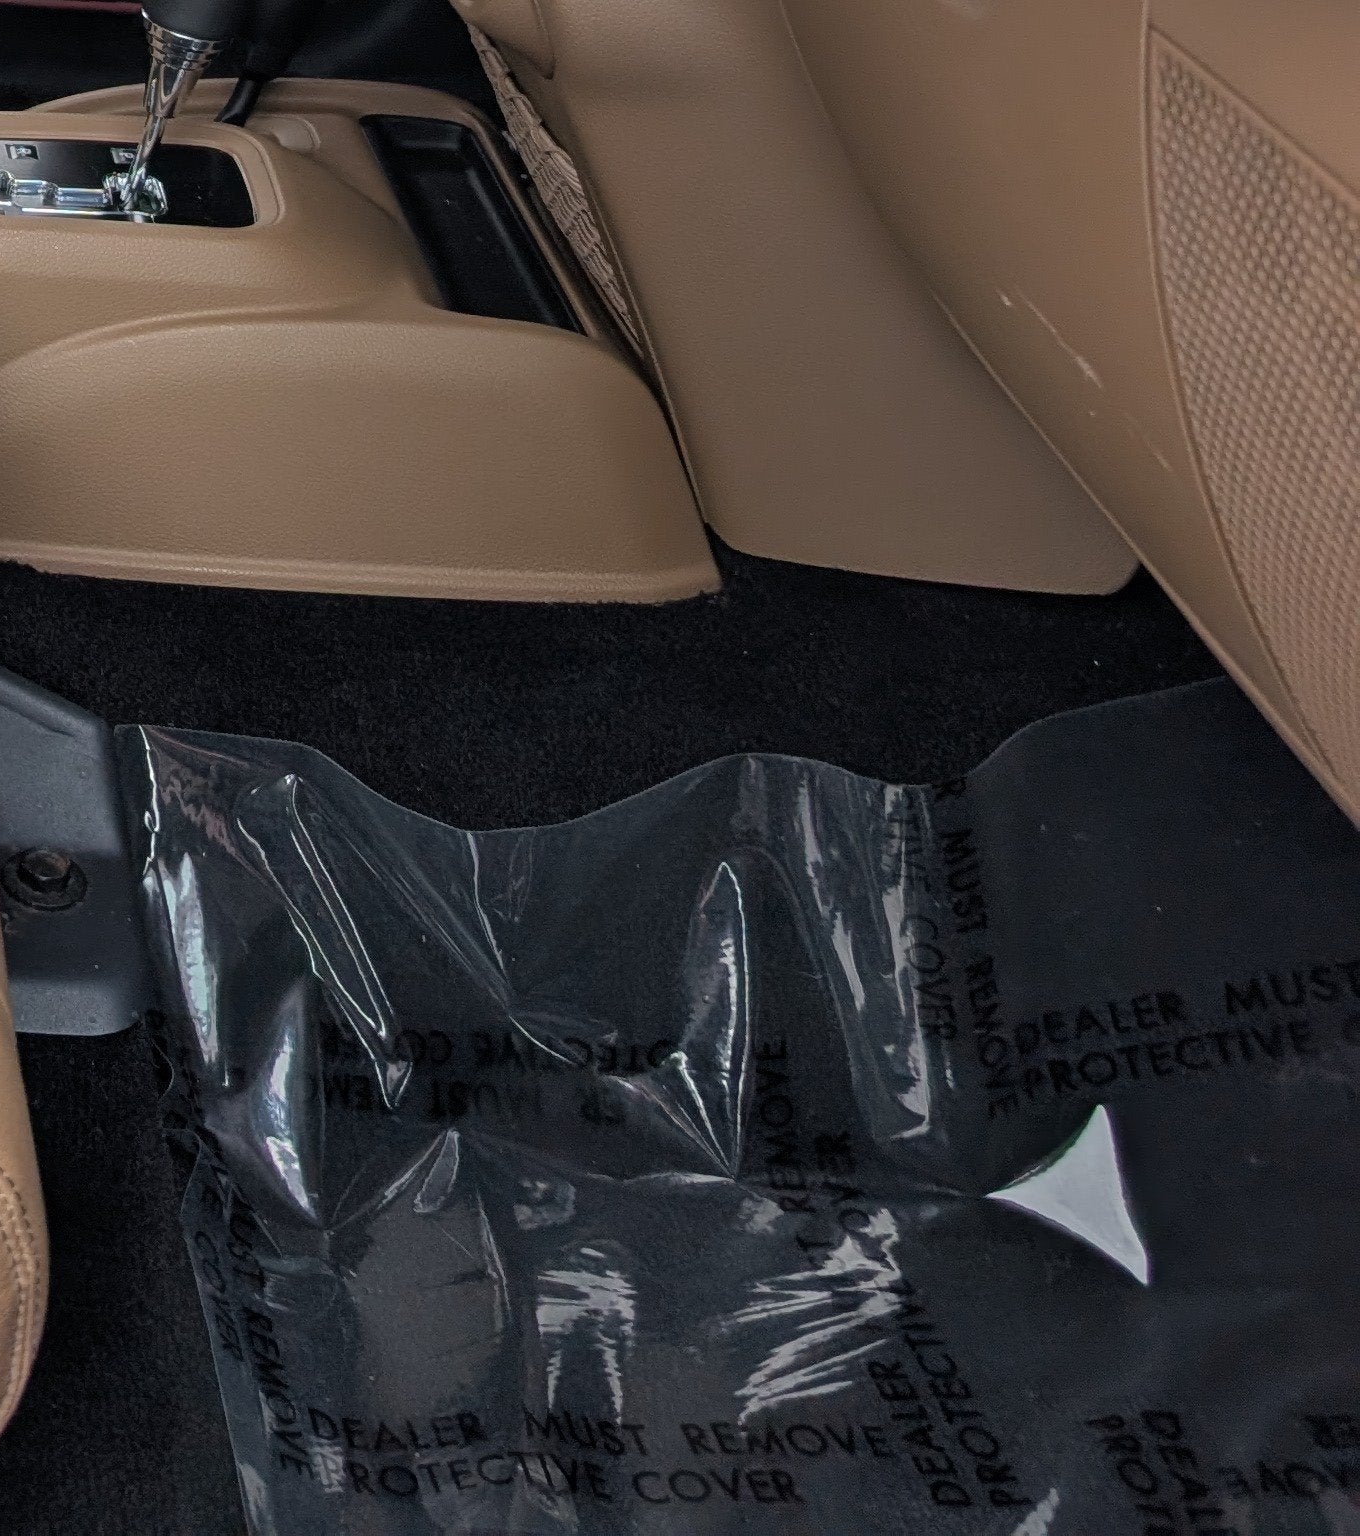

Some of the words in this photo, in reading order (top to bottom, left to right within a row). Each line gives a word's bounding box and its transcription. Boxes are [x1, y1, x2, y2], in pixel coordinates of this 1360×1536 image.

[940, 828, 989, 935] MUST
[1014, 990, 1186, 1057] DEALER
[1022, 1020, 1315, 1103] PROTECTIVE
[307, 1408, 486, 1452] DEALER
[522, 1408, 648, 1458] MUST
[681, 1422, 895, 1459] REMOVE
[867, 1360, 972, 1508] DEALER
[632, 1467, 806, 1506] COVER
